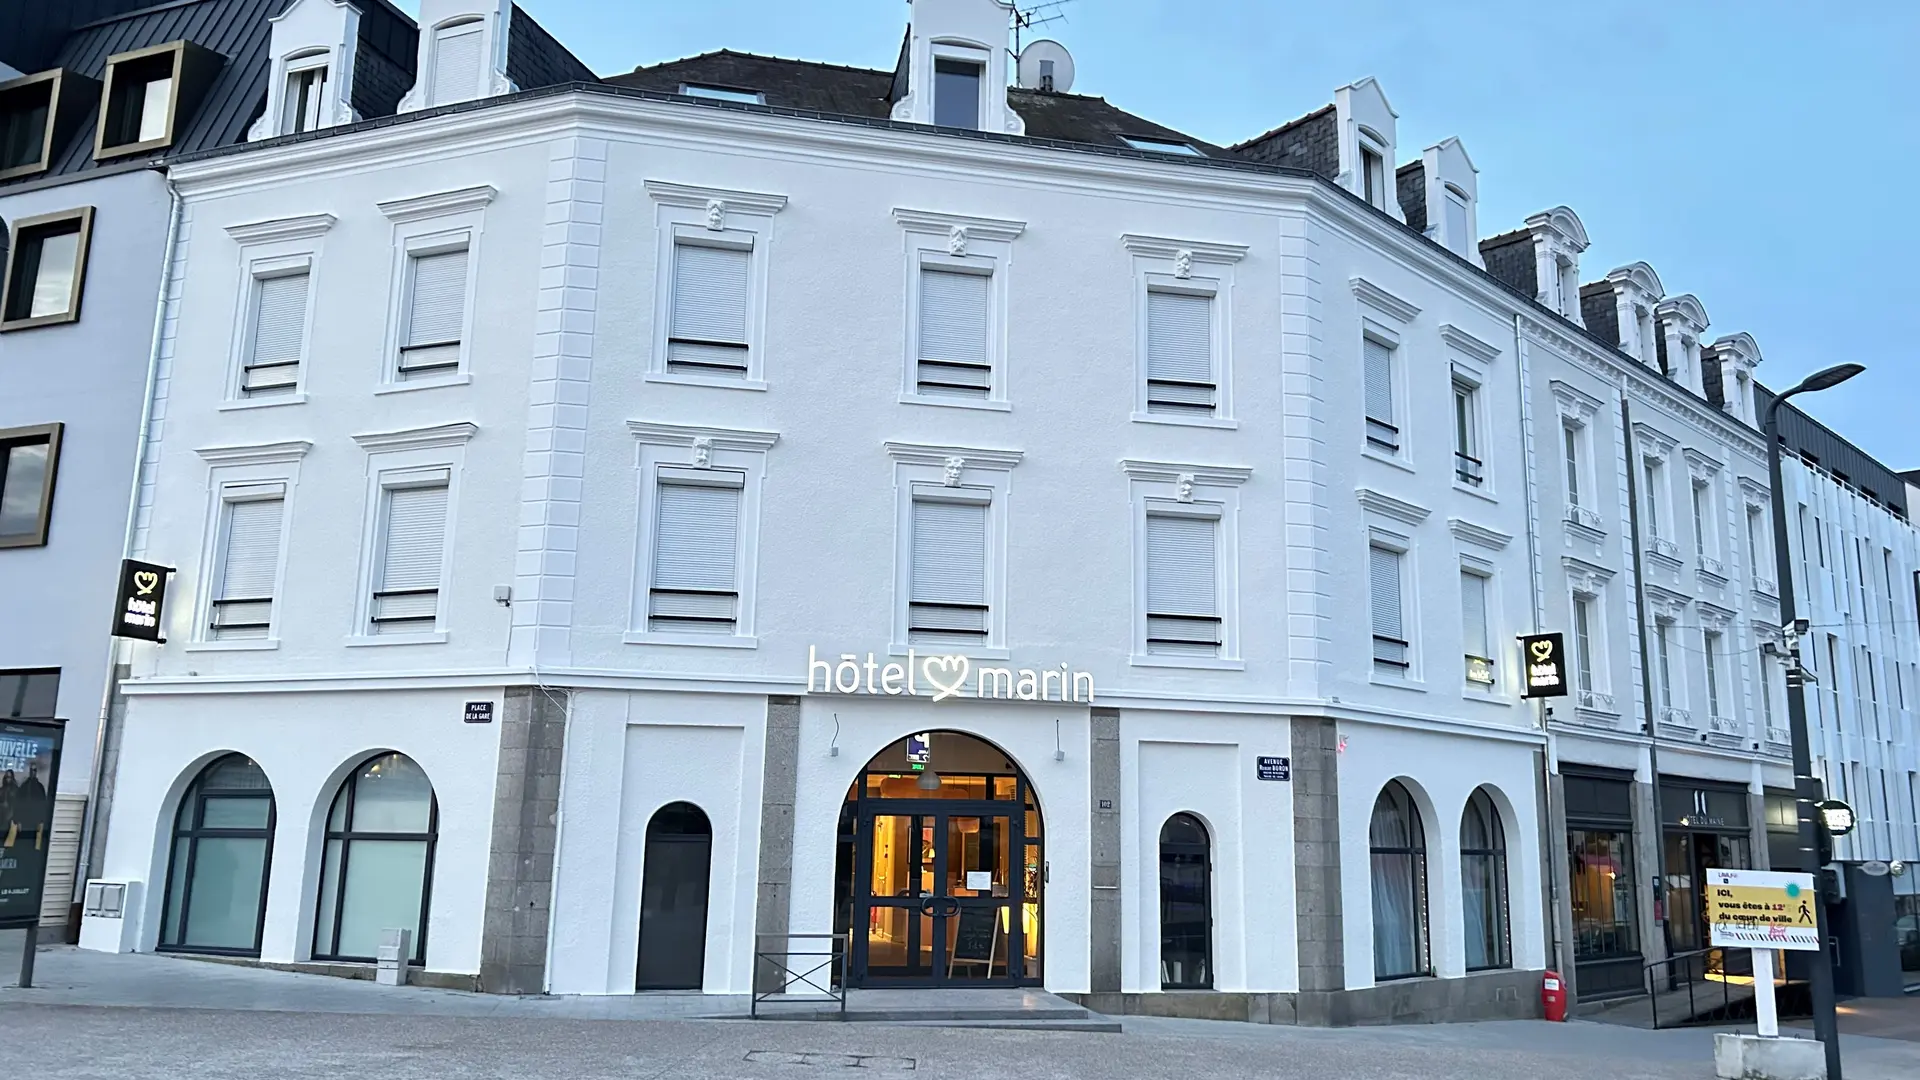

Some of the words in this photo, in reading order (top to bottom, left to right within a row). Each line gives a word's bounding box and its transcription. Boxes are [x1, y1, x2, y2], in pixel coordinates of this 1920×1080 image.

[978, 662, 1094, 702] marin
[466, 712, 471, 720] DE
[472, 712, 478, 720] LA
[1717, 889, 1733, 898] ICI,
[1742, 901, 1763, 910] êtes
[1764, 902, 1771, 910] à
[1719, 912, 1731, 920] du
[1732, 914, 1758, 922] cœur
[1759, 914, 1771, 922] de
[1772, 914, 1793, 923] ville
